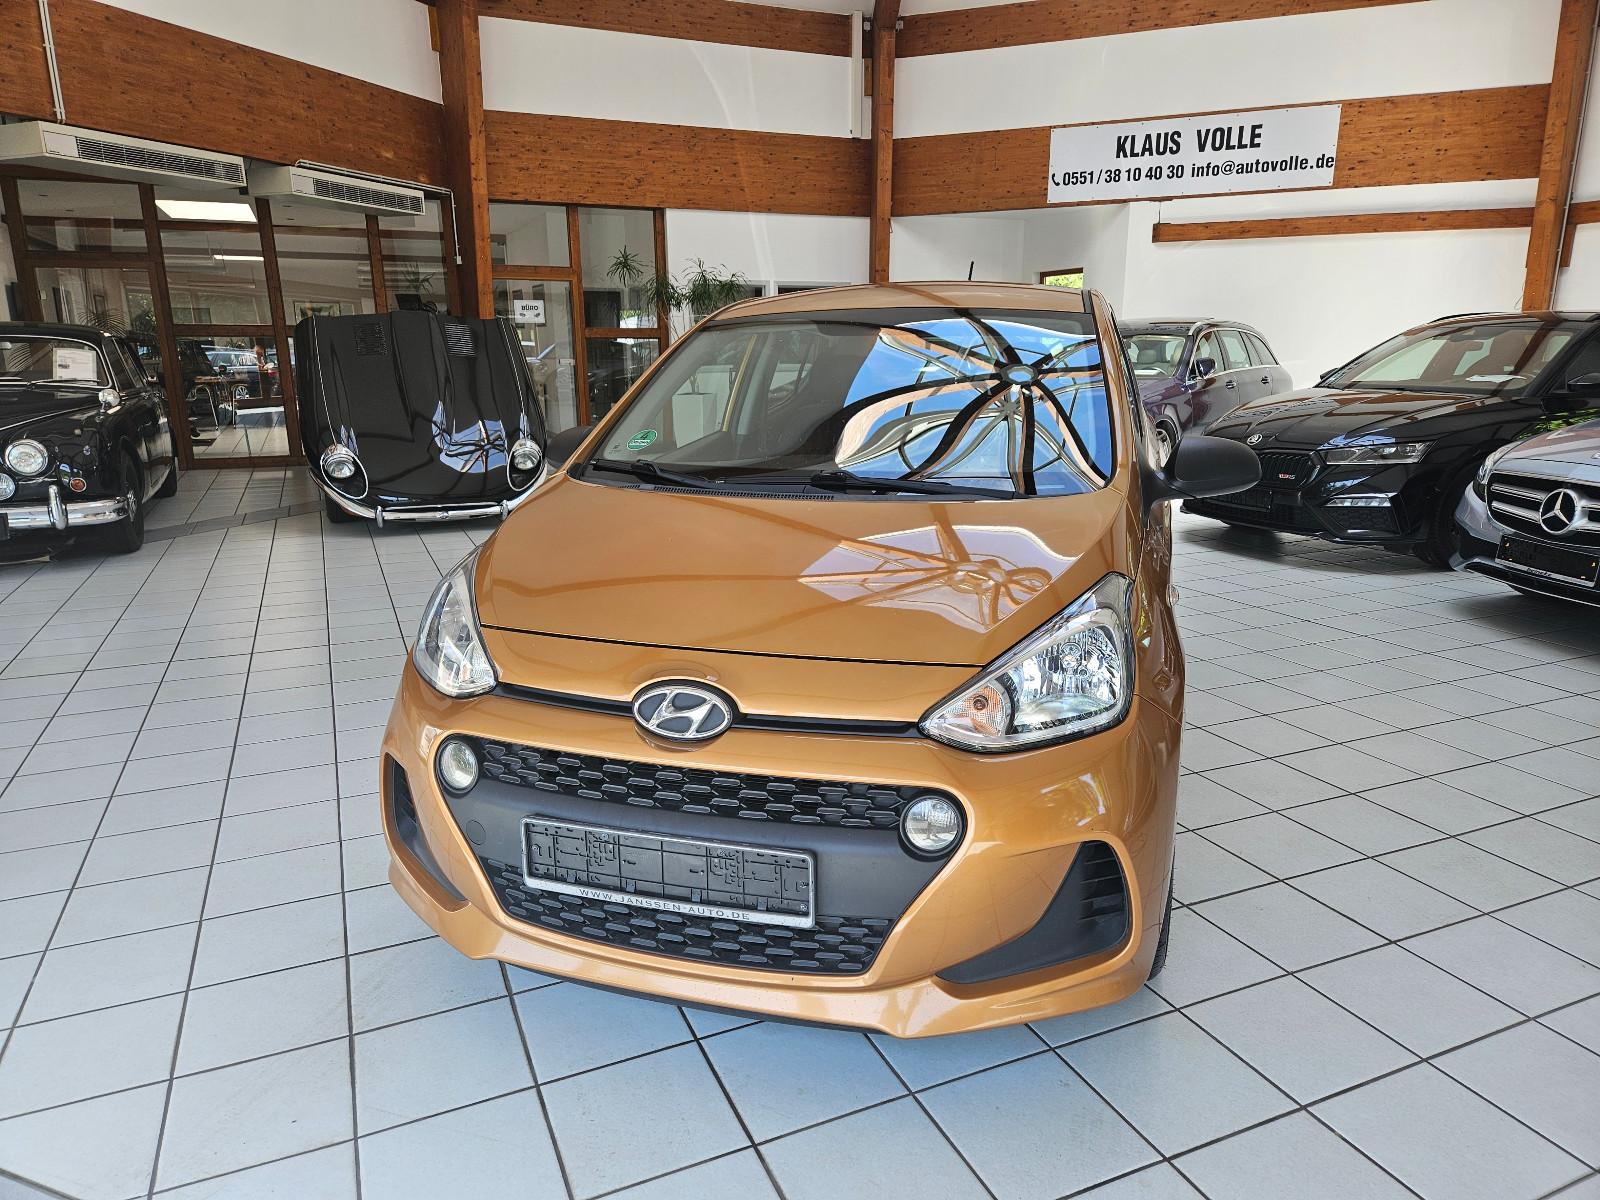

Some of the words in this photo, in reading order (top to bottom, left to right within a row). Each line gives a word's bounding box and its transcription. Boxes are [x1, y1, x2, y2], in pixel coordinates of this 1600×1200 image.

[1115, 130, 1182, 159] KLAUS
[1196, 123, 1263, 153] VOLLE
[1124, 166, 1142, 182] 10
[1144, 165, 1163, 181] 40
[1166, 164, 1185, 179] 30
[1190, 153, 1336, 179] info@autovolle.de
[579, 888, 750, 920] WWW.JANSSEN-AUTO.DE
